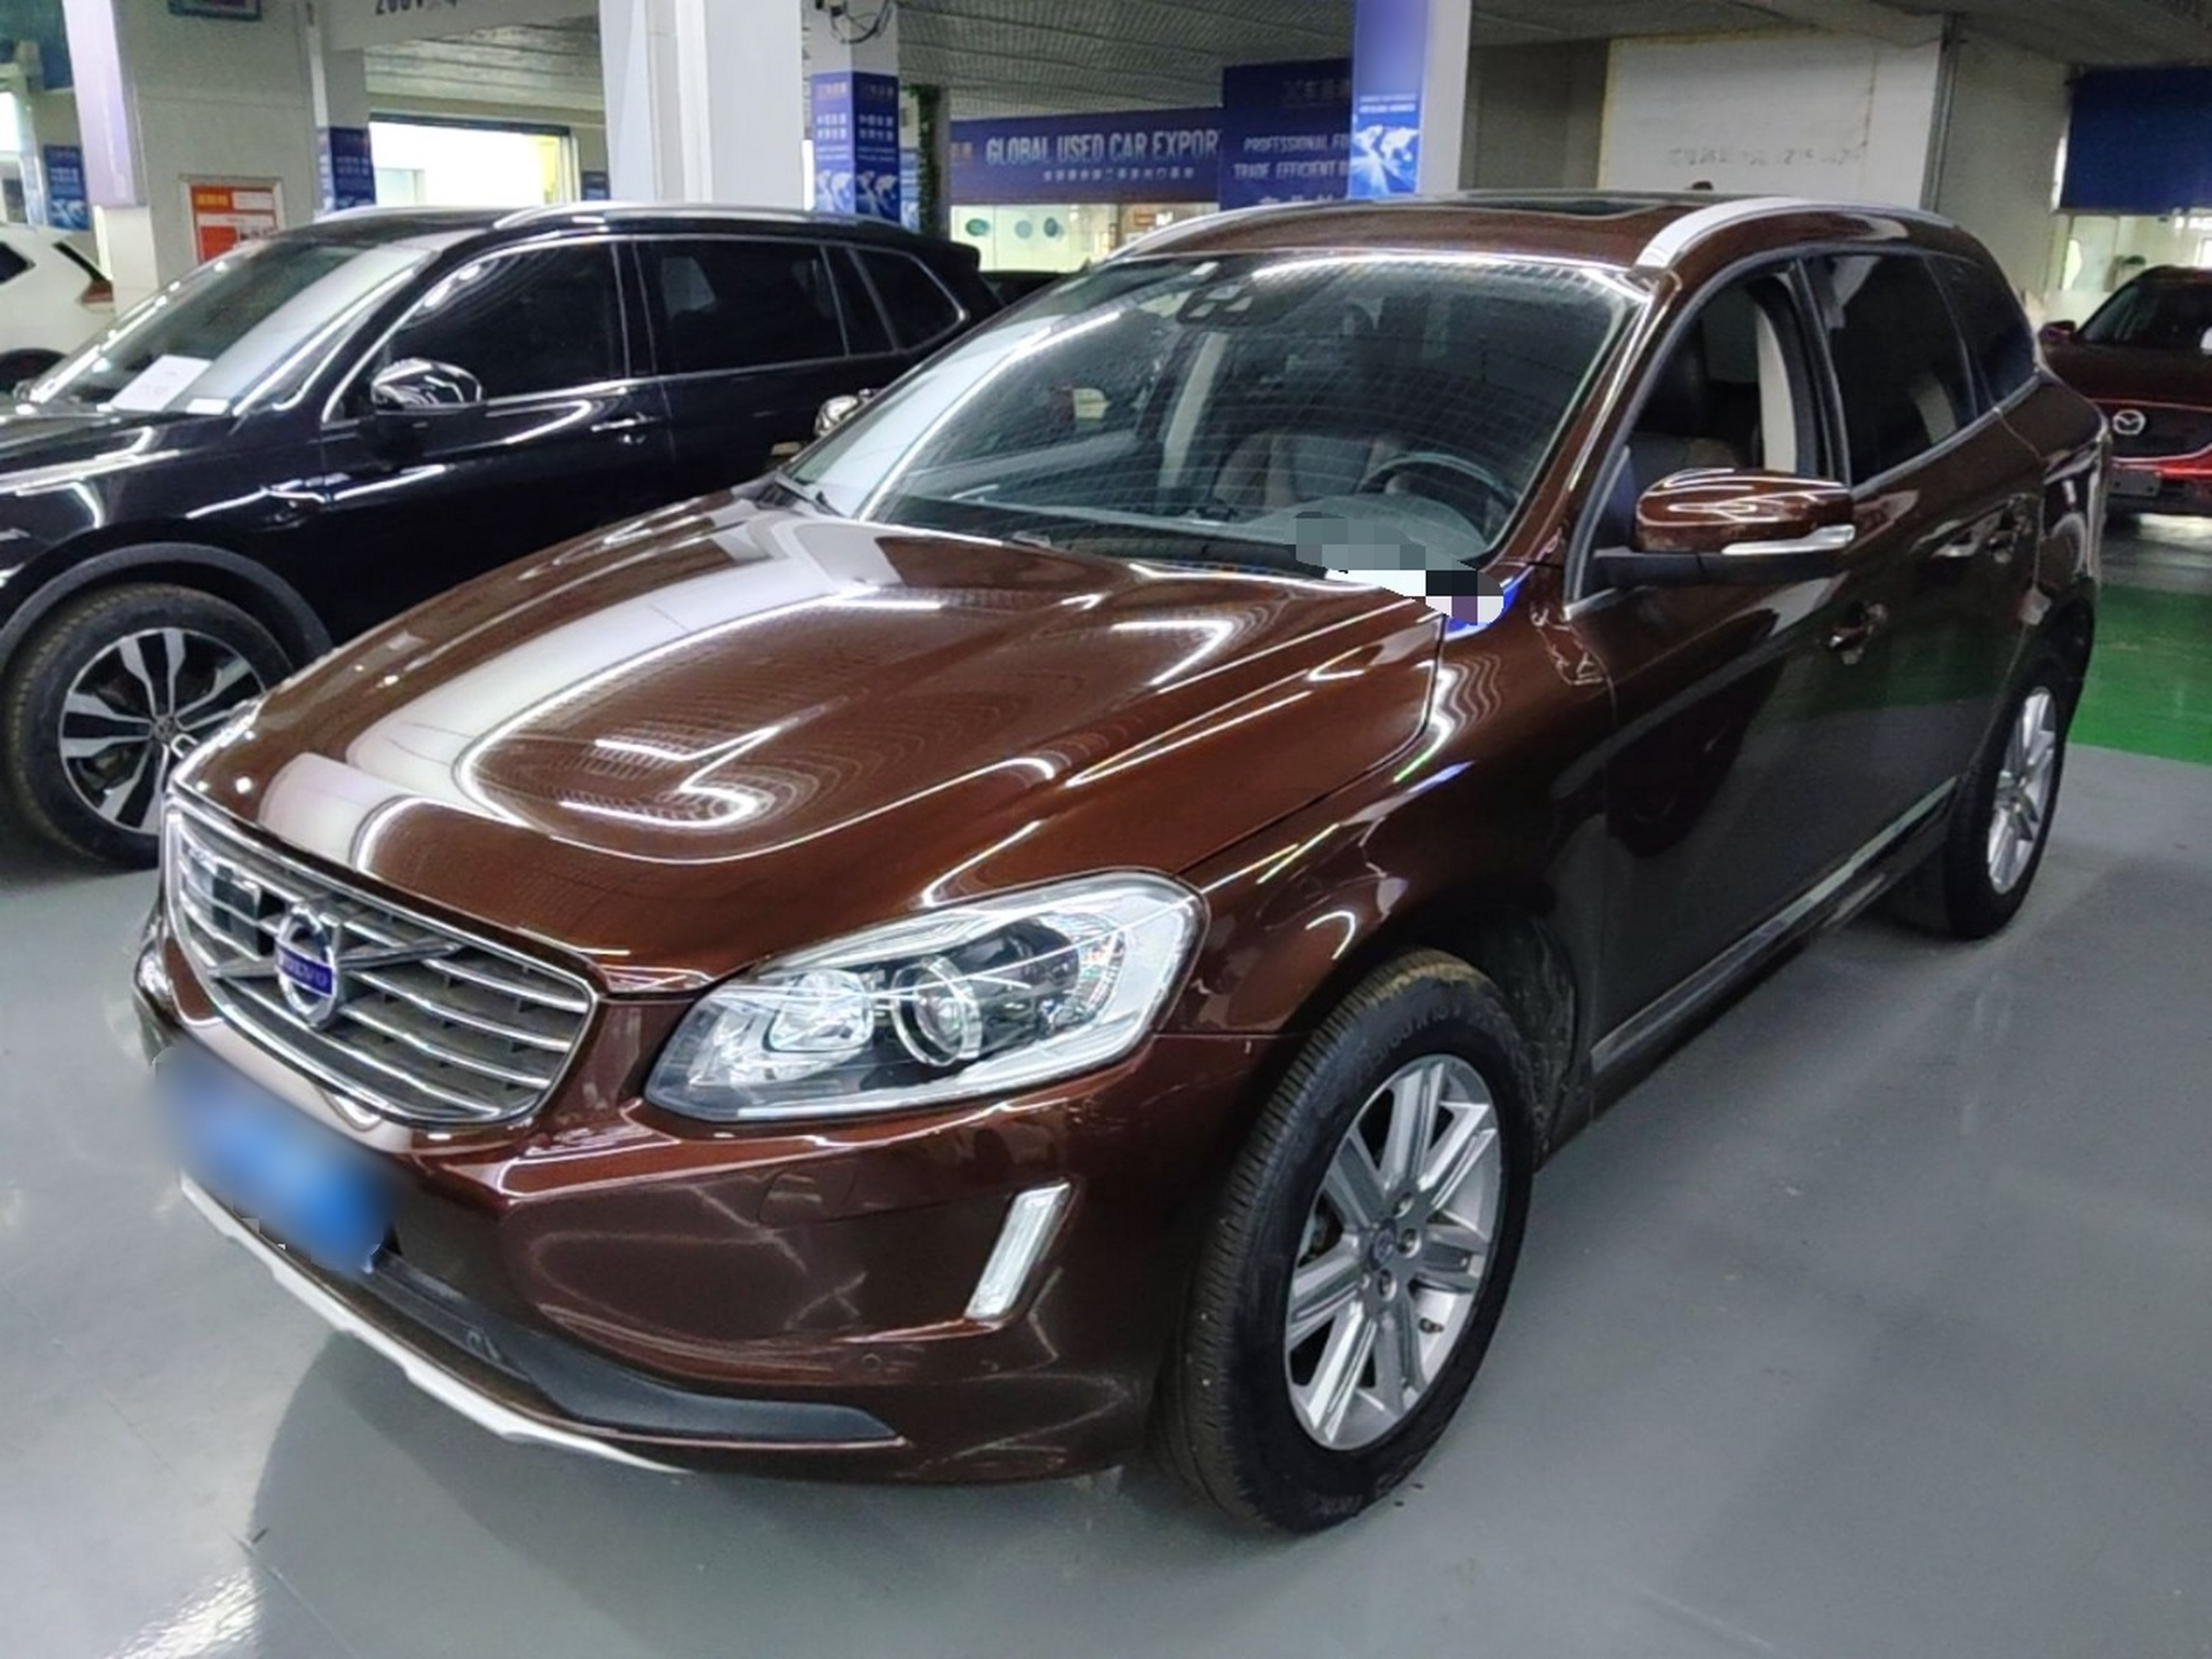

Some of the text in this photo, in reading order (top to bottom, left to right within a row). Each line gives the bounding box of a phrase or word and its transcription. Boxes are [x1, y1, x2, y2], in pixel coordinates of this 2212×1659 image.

[986, 136, 1048, 165] GLOBAL
[1057, 133, 1104, 162] USED
[1109, 131, 1147, 162] CAR
[1153, 129, 1222, 160] EXPOR
